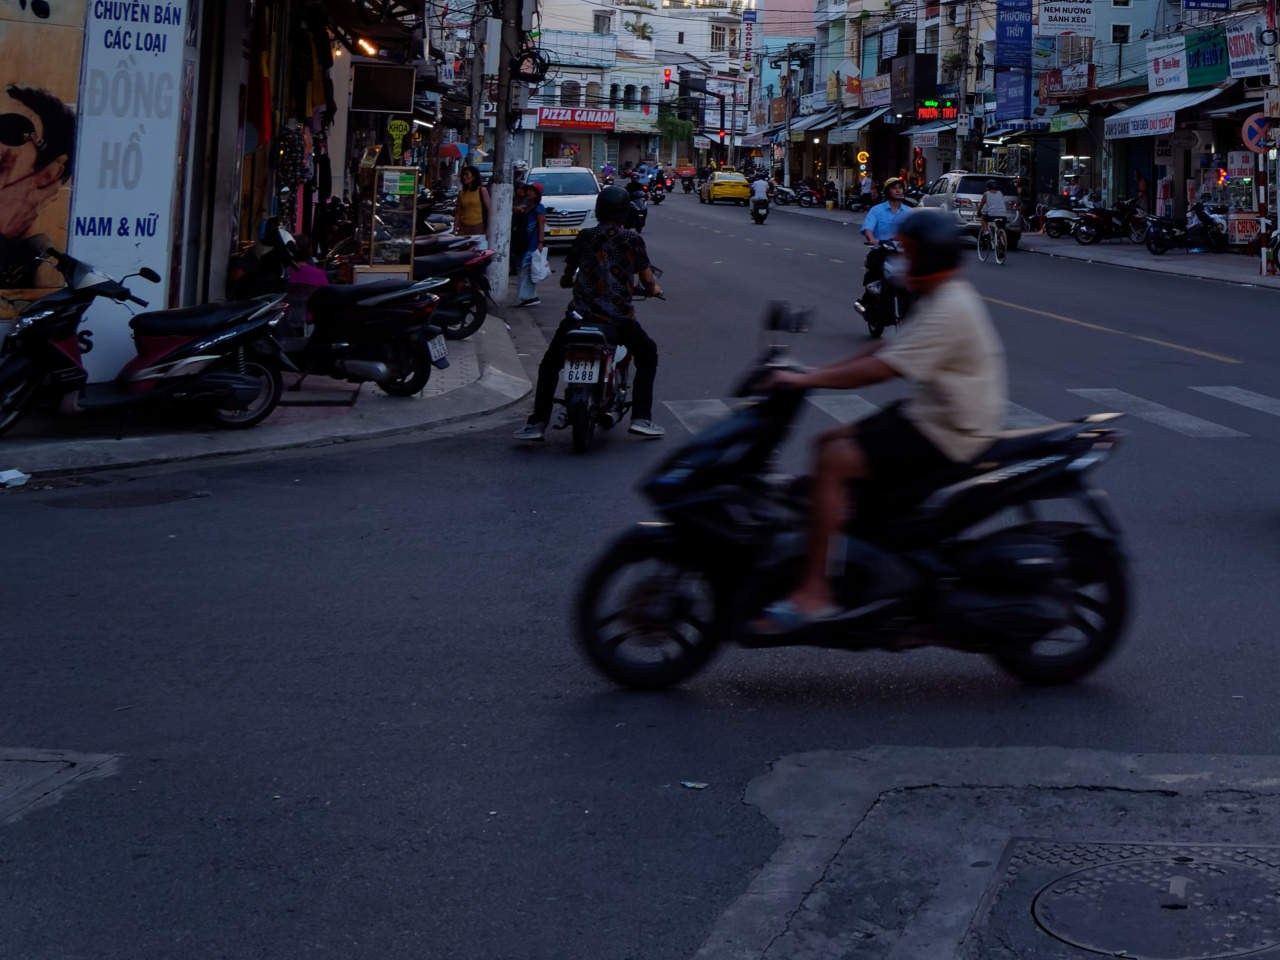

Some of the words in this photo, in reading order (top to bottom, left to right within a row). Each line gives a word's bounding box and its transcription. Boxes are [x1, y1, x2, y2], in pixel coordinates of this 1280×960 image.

[94, 0, 150, 24] CHUYÊN
[154, 1, 182, 26] BÁN
[104, 27, 132, 50] CÁC
[135, 32, 166, 56] LOẠI
[86, 54, 173, 119] ĐỒNG
[541, 108, 571, 120] PIZZA
[574, 110, 615, 122] CANADA
[97, 124, 146, 190] HỒ
[75, 217, 112, 236] NAM
[116, 217, 130, 237] &
[134, 211, 159, 237] NỮ
